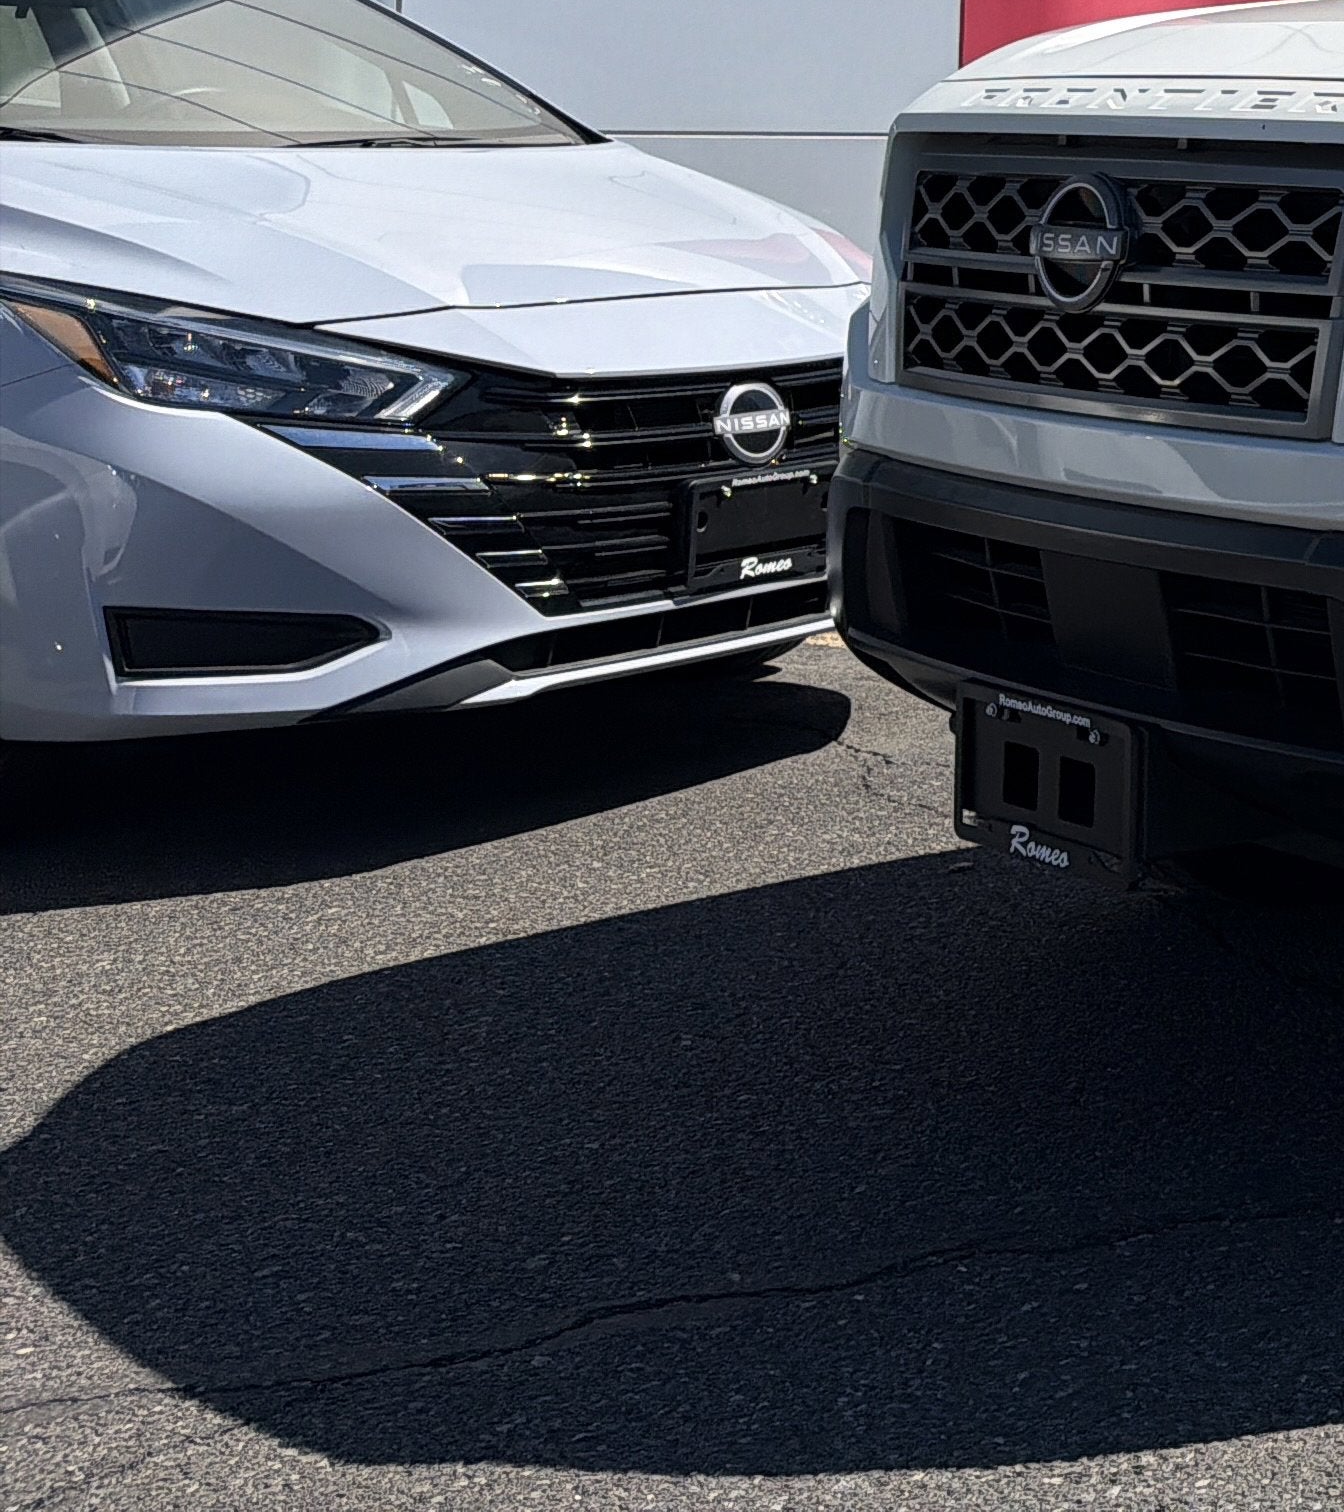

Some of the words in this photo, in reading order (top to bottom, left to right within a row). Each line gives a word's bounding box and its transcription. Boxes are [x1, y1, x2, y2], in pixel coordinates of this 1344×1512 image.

[715, 412, 790, 433] NISSAN
[732, 469, 811, 486] RomeoAutoGroup.com
[739, 555, 793, 579] Romeo
[998, 692, 1092, 730] RomeoAutoGroup.com
[1009, 824, 1070, 868] Romeo
